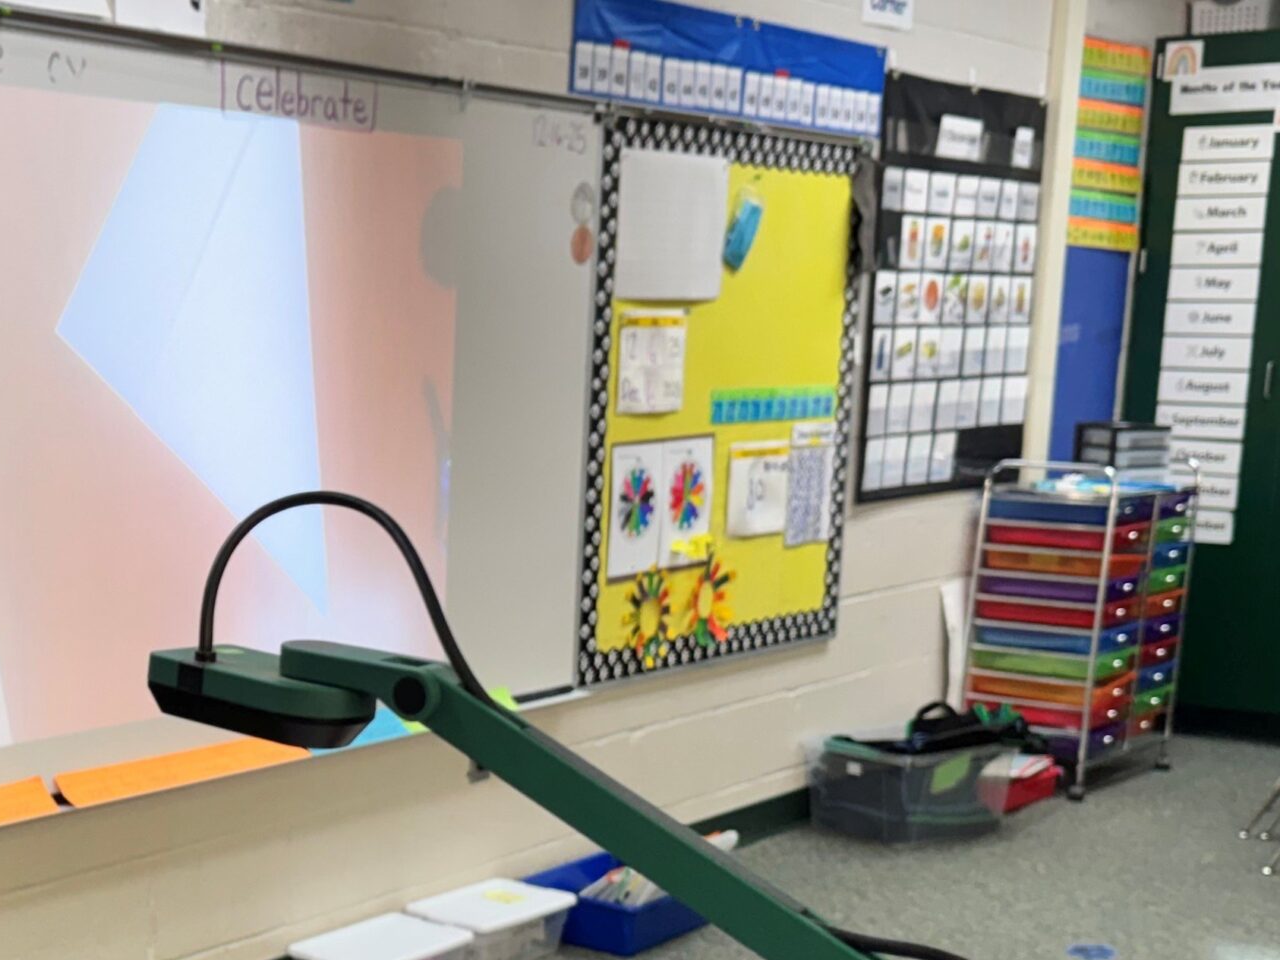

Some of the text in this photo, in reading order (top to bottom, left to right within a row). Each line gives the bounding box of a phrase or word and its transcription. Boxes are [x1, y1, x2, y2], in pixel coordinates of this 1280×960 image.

[236, 66, 368, 124] celebrate
[1209, 136, 1259, 151] January
[1199, 172, 1258, 187] February
[1207, 205, 1247, 218] March
[1207, 242, 1239, 256] April
[1185, 381, 1231, 394] August
[1171, 412, 1241, 429] September
